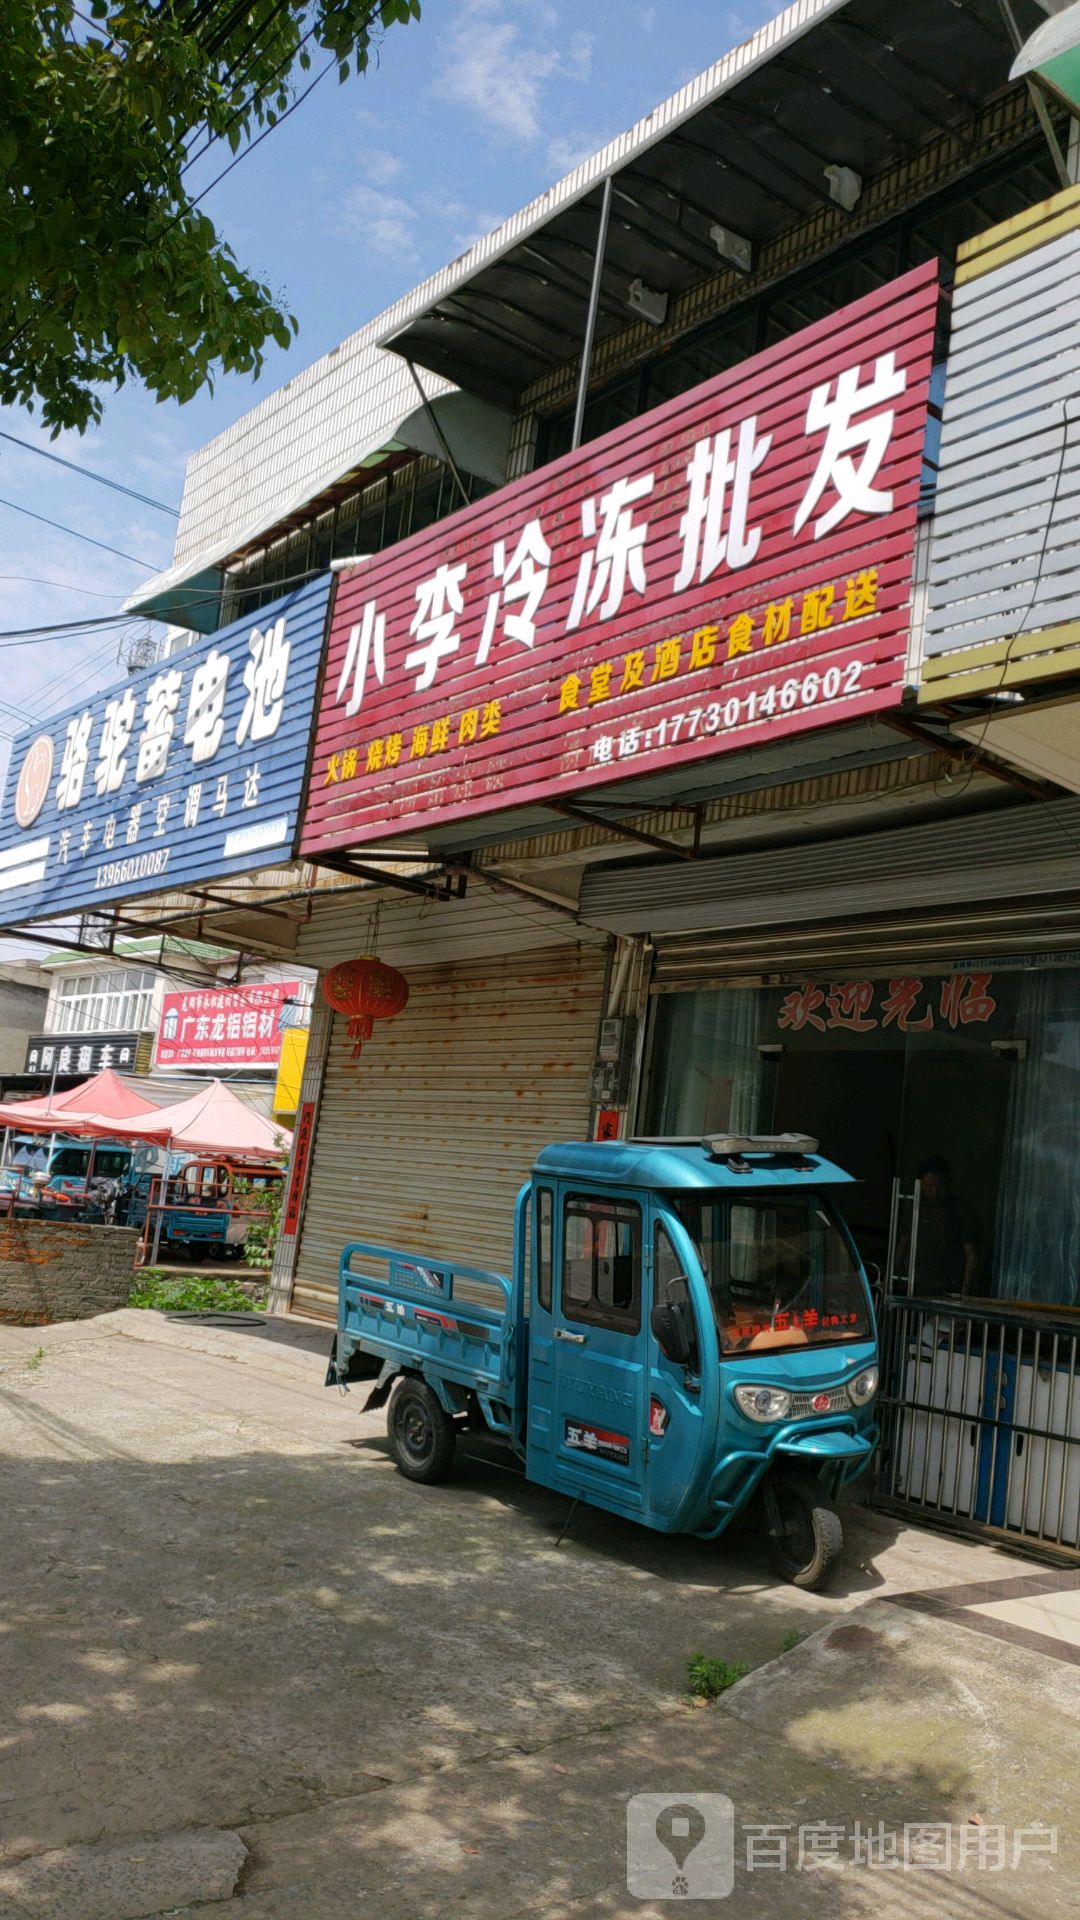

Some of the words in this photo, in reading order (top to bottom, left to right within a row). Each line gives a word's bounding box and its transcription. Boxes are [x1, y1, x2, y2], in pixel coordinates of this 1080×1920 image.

[336, 352, 906, 717] 小李冷冻批发
[558, 567, 880, 714] 食堂及酒店食材配送
[56, 617, 292, 812] 骆驼蓄电池
[323, 747, 360, 785] 火锅
[366, 731, 404, 774] 烧烤
[410, 715, 452, 760] 海鲜
[458, 697, 503, 744] 肉类
[591, 659, 864, 763] 电话:17730146602
[94, 848, 171, 889] 13966010087
[180, 1009, 276, 1042] 广东龙铝铝材
[777, 973, 997, 1033] 欢迎光临
[774, 1308, 819, 1331] 五羊
[566, 1426, 597, 1451] 五羊
